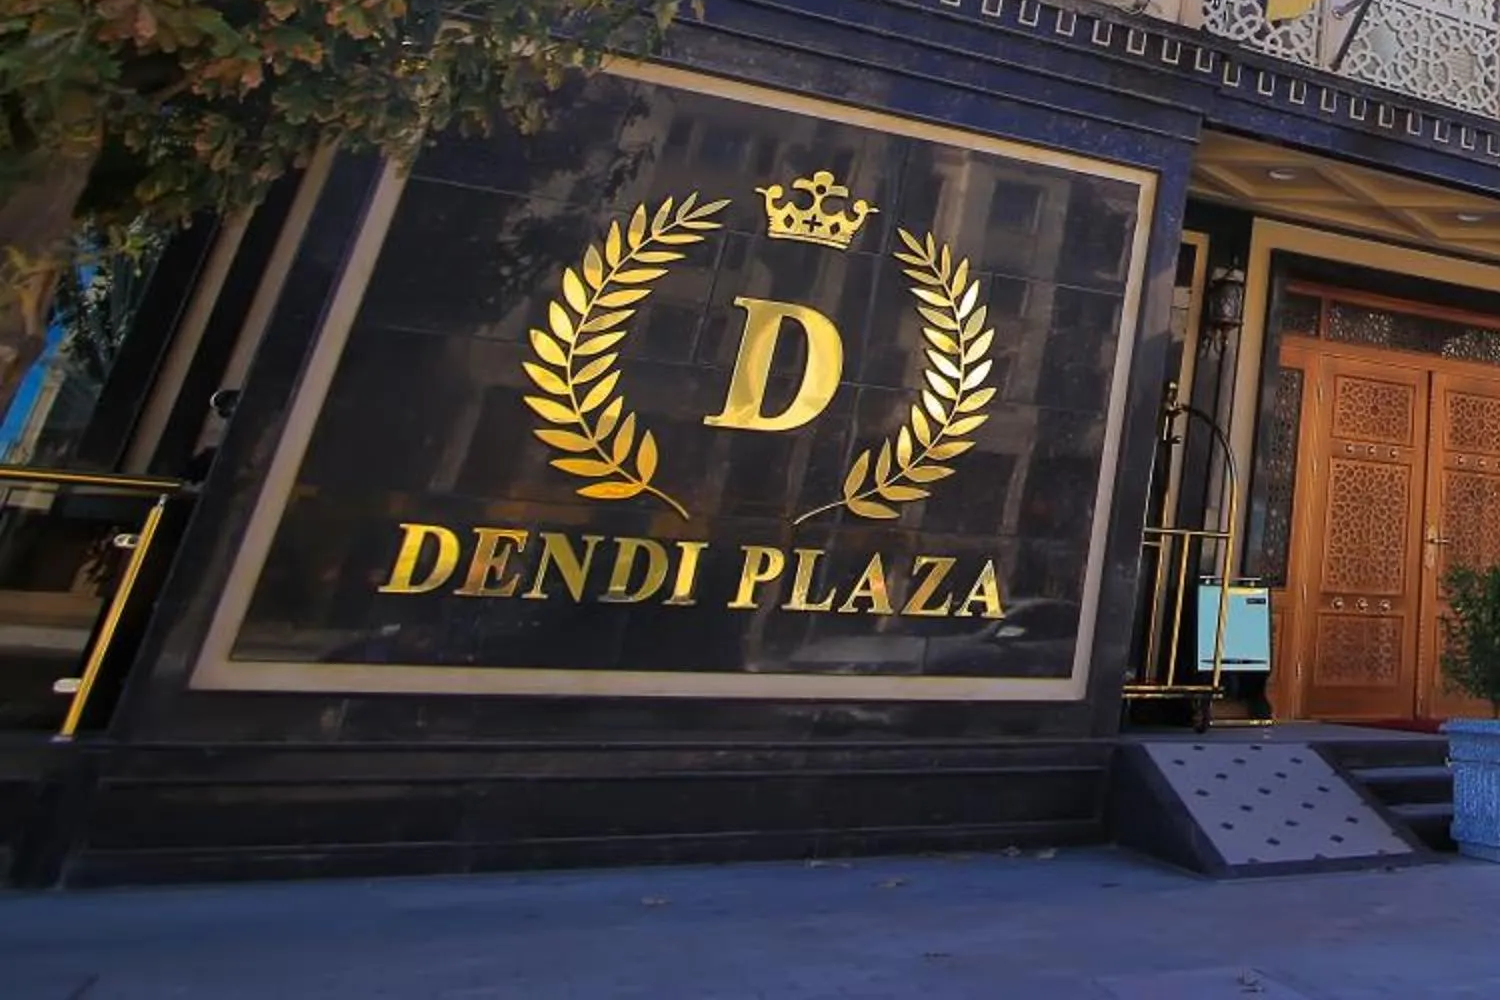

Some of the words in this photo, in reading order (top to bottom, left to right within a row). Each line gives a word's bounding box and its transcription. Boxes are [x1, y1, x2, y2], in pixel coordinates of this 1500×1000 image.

[704, 296, 845, 432] D
[377, 522, 708, 607] DENDI
[728, 545, 1006, 620] PLAZA
